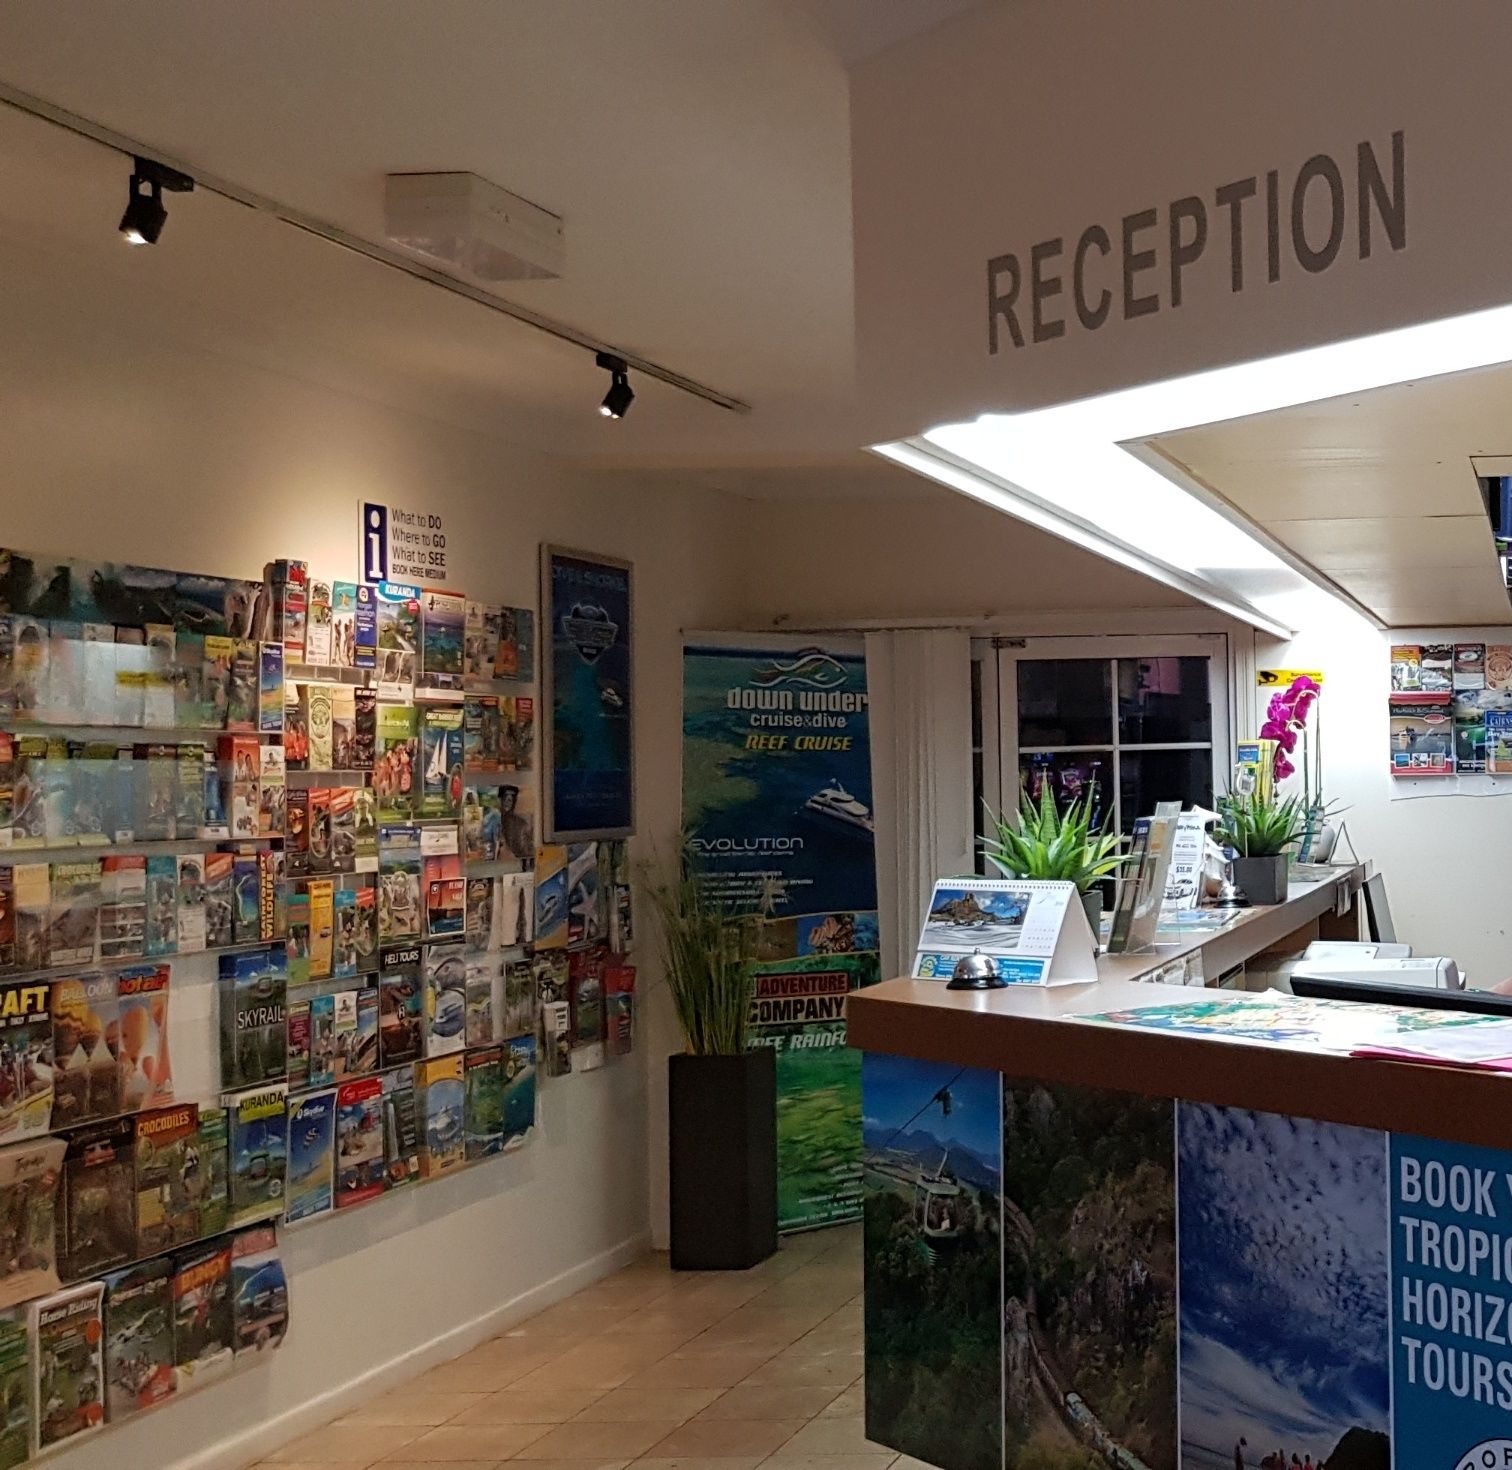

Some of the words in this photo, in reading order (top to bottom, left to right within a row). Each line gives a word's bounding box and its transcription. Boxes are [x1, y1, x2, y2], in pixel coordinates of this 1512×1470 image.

[988, 130, 1406, 355] RECEPTION
[392, 508, 415, 525] What
[417, 515, 426, 527] to
[428, 514, 442, 530] DO
[392, 527, 420, 544] Where
[422, 535, 431, 546] to
[432, 534, 446, 548] GO
[392, 546, 415, 562] What
[418, 551, 427, 564] to
[428, 551, 446, 567] SEE
[727, 686, 793, 711] down
[801, 690, 869, 712] under
[745, 734, 788, 750] REEF
[794, 735, 853, 750] CRUISE
[689, 837, 804, 850] EVOLUTION
[399, 950, 419, 963] TOURS
[759, 974, 846, 995] ADVENTURE
[0, 985, 50, 1017] AFT
[749, 996, 845, 1023] COMPANY
[237, 1004, 285, 1030] SKYRAIL
[240, 1091, 285, 1112] KURANDA
[137, 1110, 191, 1137] CROCODILES
[1400, 1156, 1497, 1218] BOOK
[67, 1296, 98, 1316] Riding
